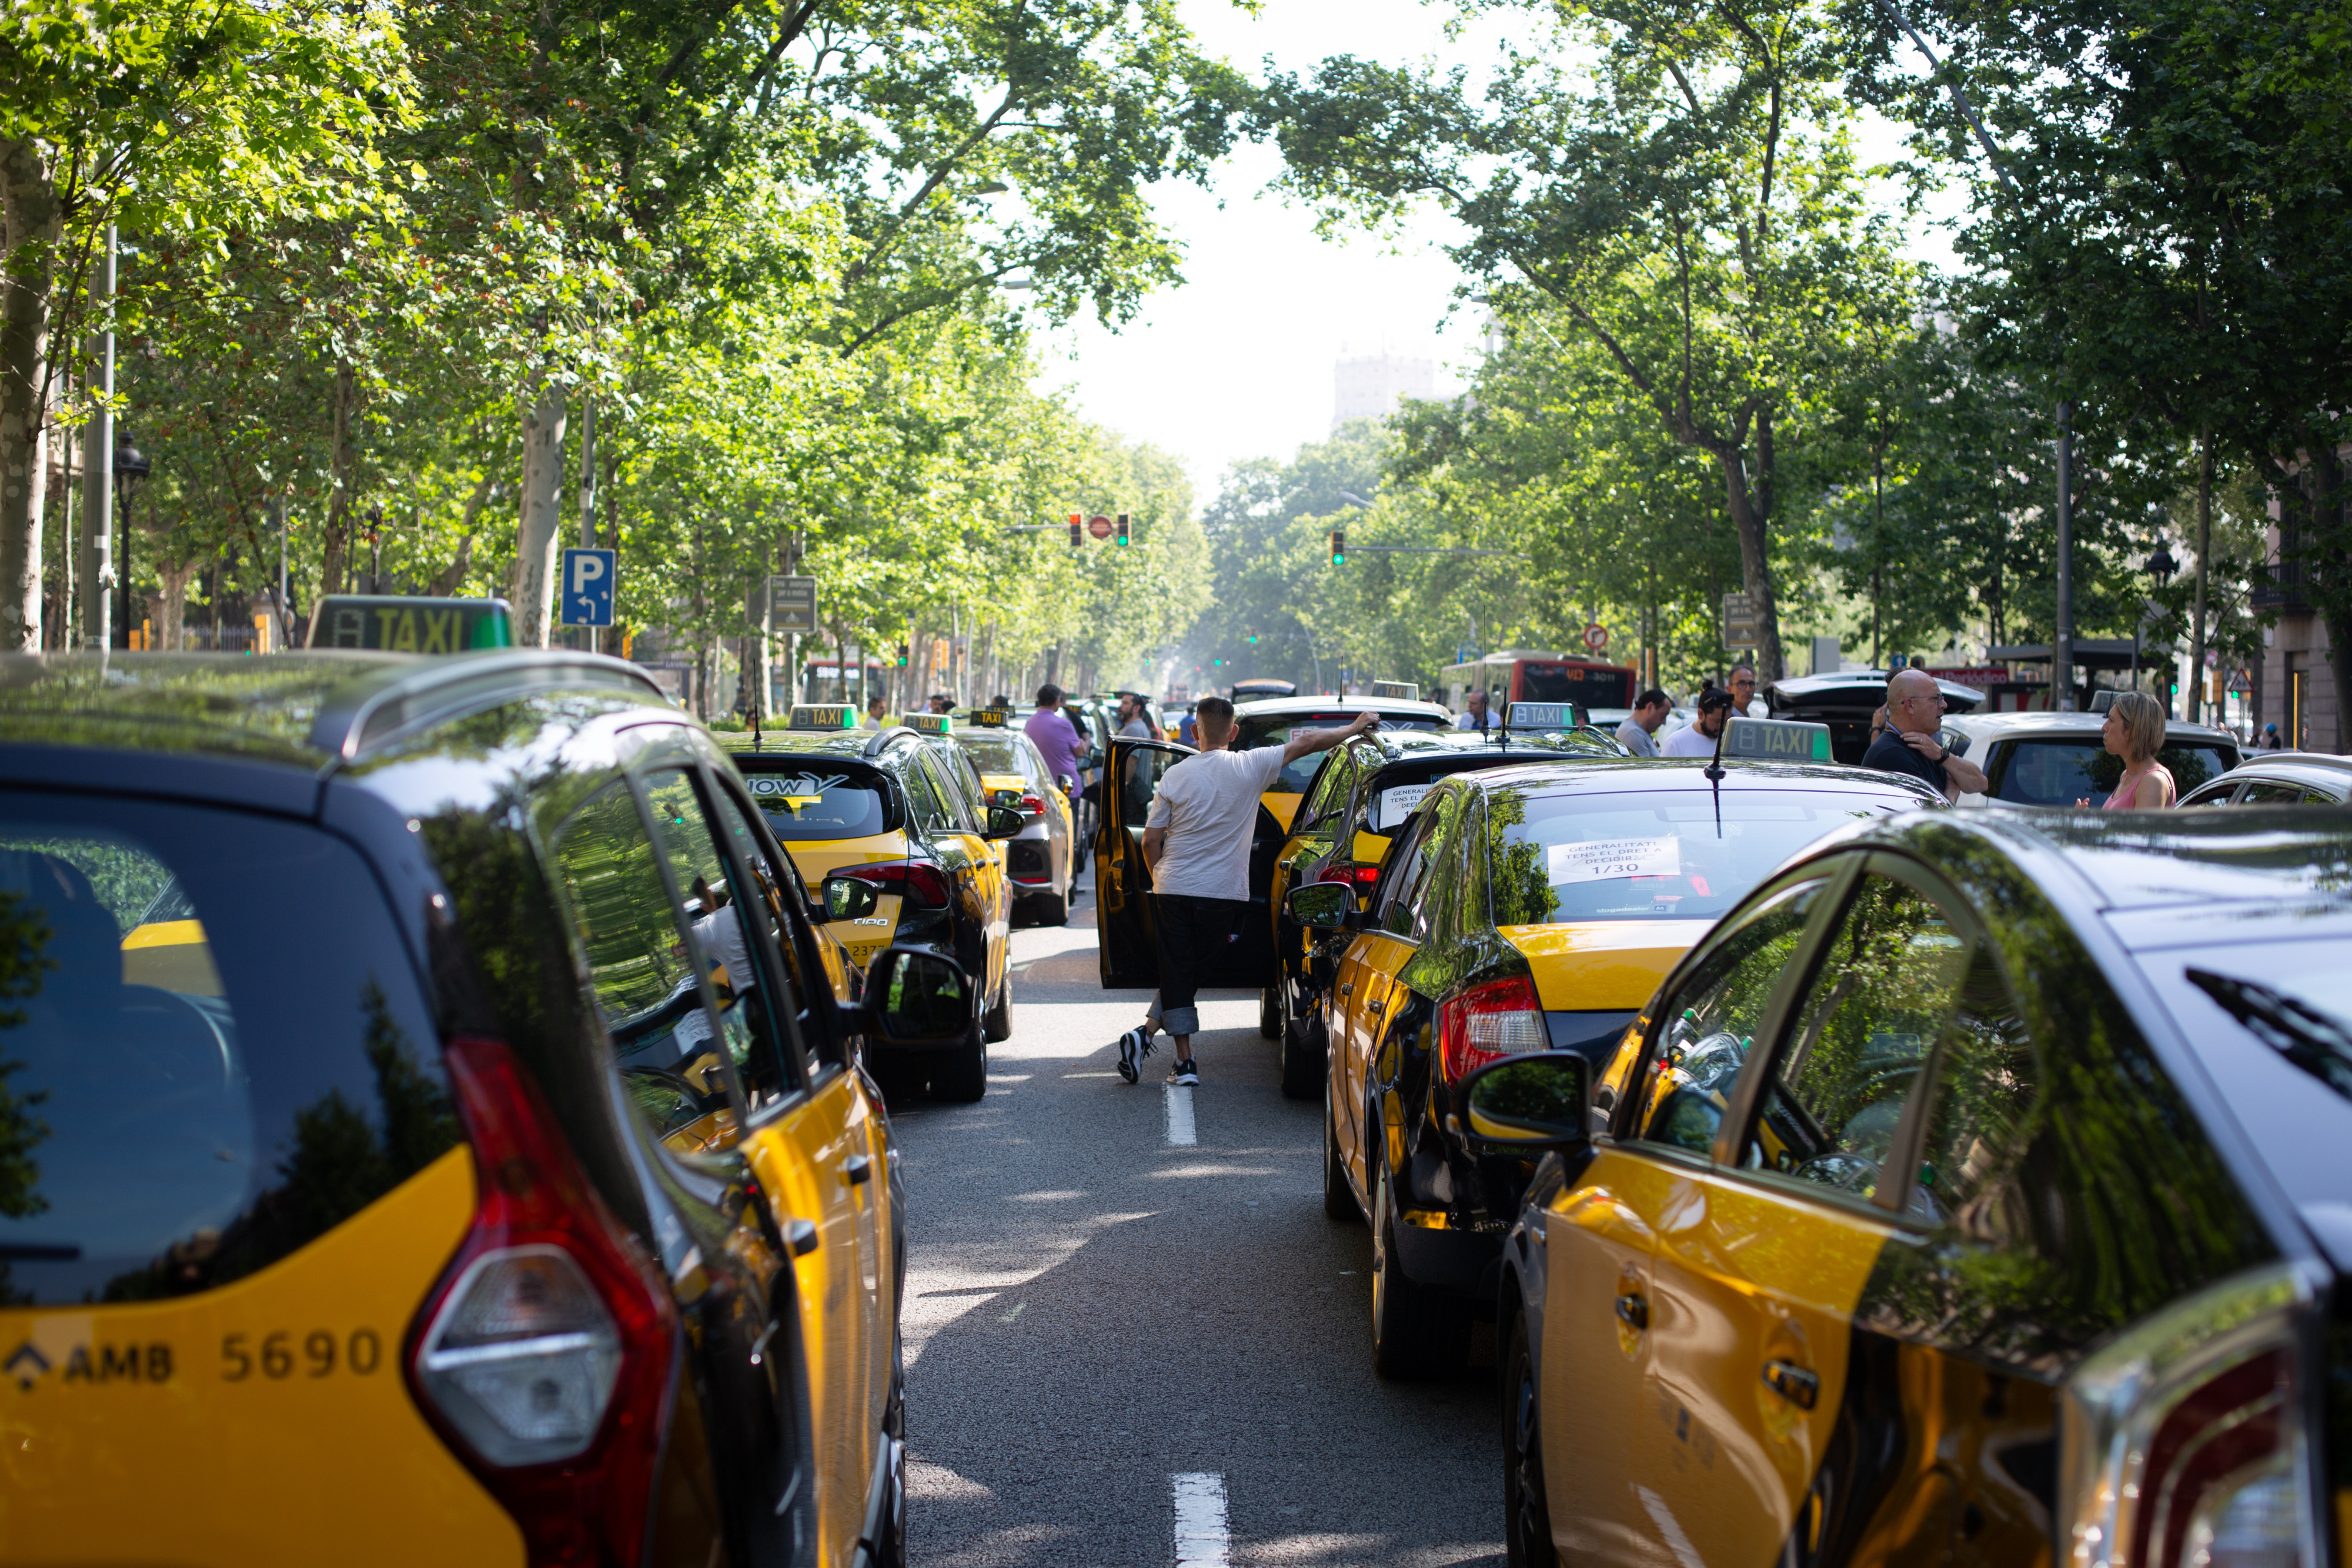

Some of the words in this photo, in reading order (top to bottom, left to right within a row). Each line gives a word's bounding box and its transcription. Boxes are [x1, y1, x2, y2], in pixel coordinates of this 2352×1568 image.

[573, 555, 604, 593] P
[375, 608, 463, 653] TAXI
[1385, 685, 1406, 698] TAXI
[812, 708, 841, 725] TAXI
[981, 712, 1001, 724] TAXI
[1531, 707, 1559, 723] TAXI
[918, 717, 941, 730] TAXI
[1762, 726, 1809, 754] TAXI
[1569, 841, 1656, 852] GENERALITAT!
[1592, 863, 1638, 874] 1/30
[65, 1340, 174, 1383] AMB
[220, 1329, 382, 1382] 5690
